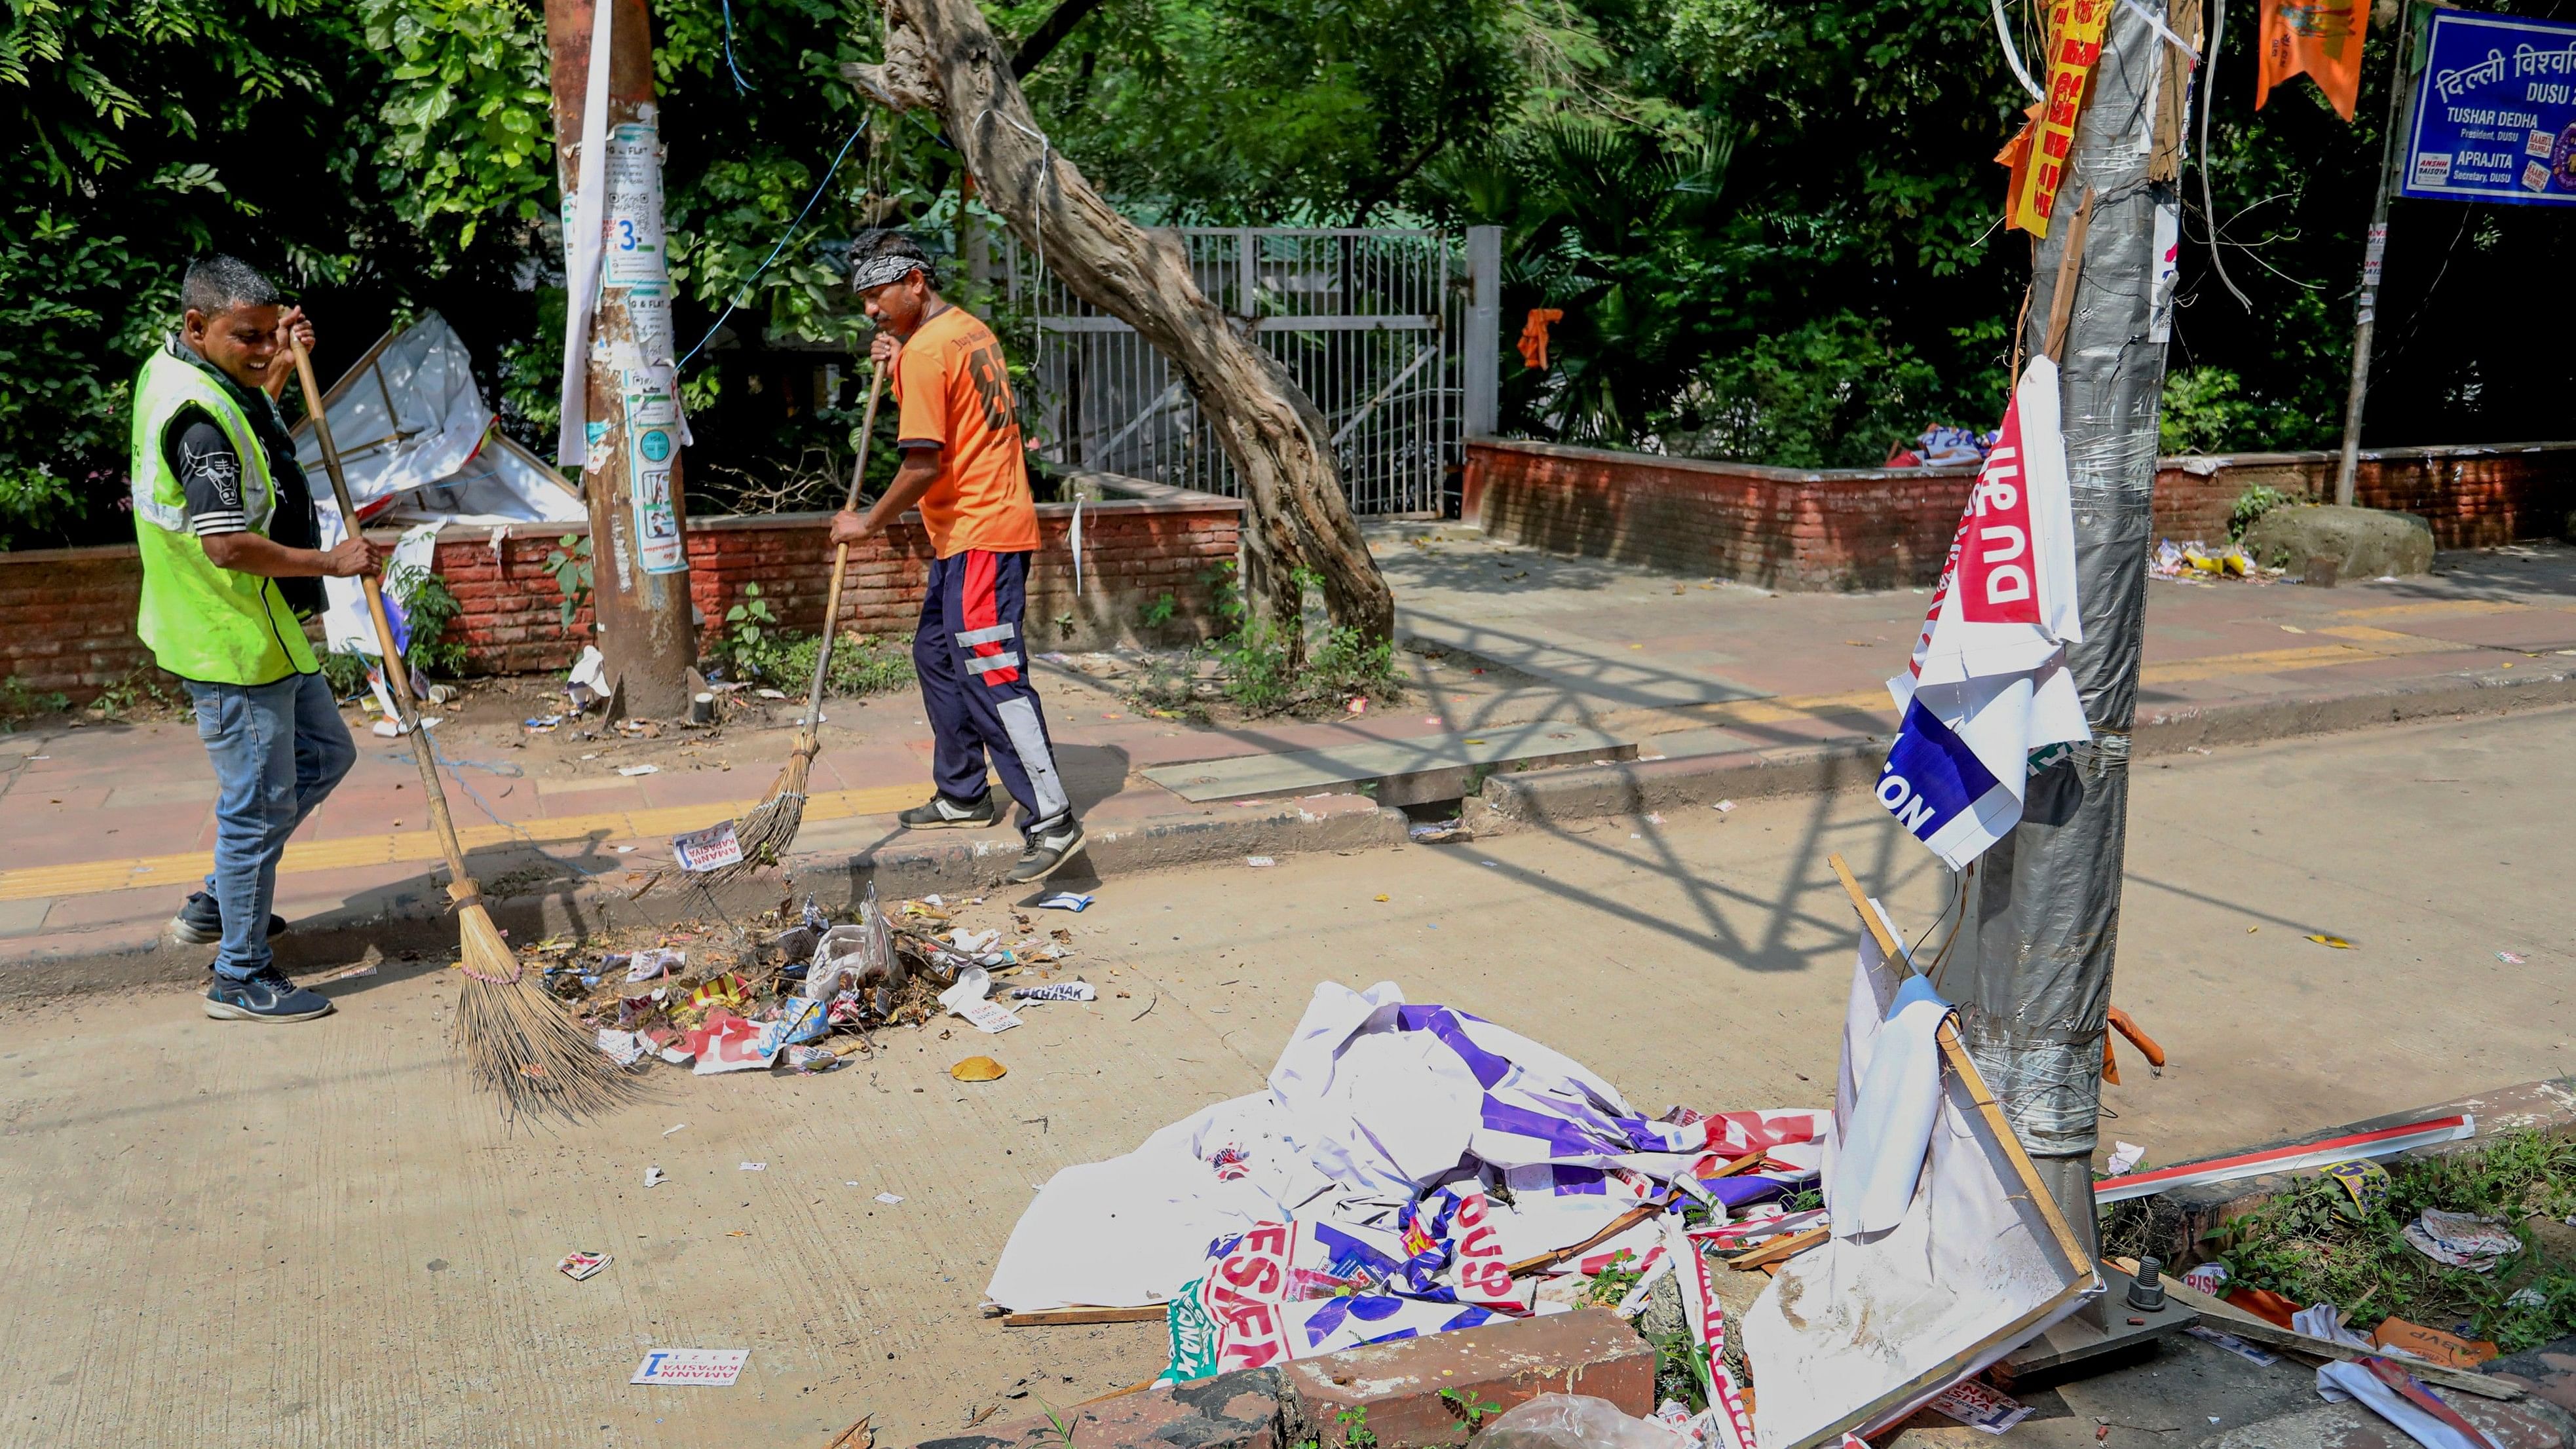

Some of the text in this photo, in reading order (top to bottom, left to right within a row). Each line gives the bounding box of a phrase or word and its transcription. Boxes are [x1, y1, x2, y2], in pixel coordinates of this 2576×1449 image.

[2434, 48, 2506, 104] दिल्ली
[2526, 83, 2569, 105] DUSU
[2447, 107, 2538, 128] TUSHAR DEDHA
[2497, 131, 2519, 142] DUSU
[2456, 151, 2513, 168] APRAJITA
[2453, 170, 2488, 183] Secretary,
[2490, 173, 2511, 183] DUSU
[619, 219, 636, 251] 3
[649, 300, 664, 309] FLAT
[1981, 524, 2030, 605] DU
[675, 839, 692, 868] 1
[689, 838, 735, 857] KAPASIYA
[693, 846, 736, 865] AMANN
[645, 1354, 669, 1376] 1
